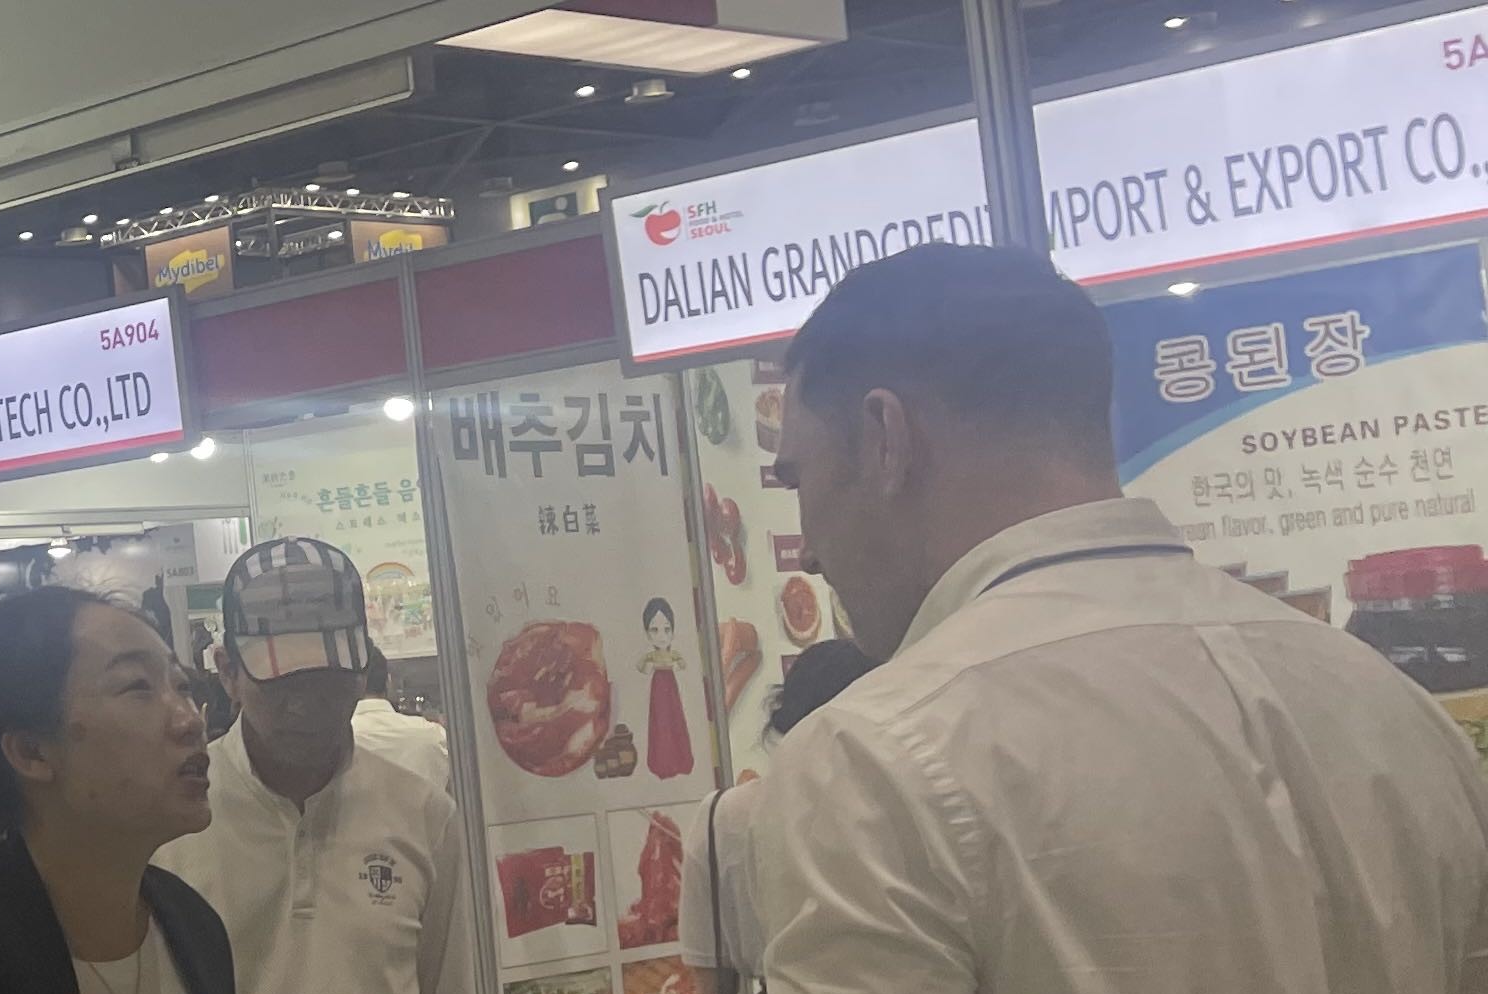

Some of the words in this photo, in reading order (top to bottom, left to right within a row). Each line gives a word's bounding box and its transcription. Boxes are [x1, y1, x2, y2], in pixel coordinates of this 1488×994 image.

[638, 252, 753, 325] DALIAN
[1185, 164, 1217, 225] &
[1225, 126, 1388, 218] EXPORT
[687, 200, 717, 219] SFH
[690, 223, 733, 239] SEOUL
[158, 254, 221, 281] Mydibel
[100, 318, 160, 350] 5A904
[59, 371, 151, 433] CO.,LTD
[450, 391, 668, 478] 배추김치
[1242, 417, 1380, 455] SOYBEAN
[1393, 404, 1488, 436] PASTE
[1192, 473, 1255, 507] 한국의
[1301, 459, 1344, 493] 녹색
[1353, 453, 1398, 489] 순수
[1280, 506, 1327, 536] green
[1332, 500, 1364, 526] and
[1370, 501, 1409, 527] pure
[1415, 489, 1475, 520] natural
